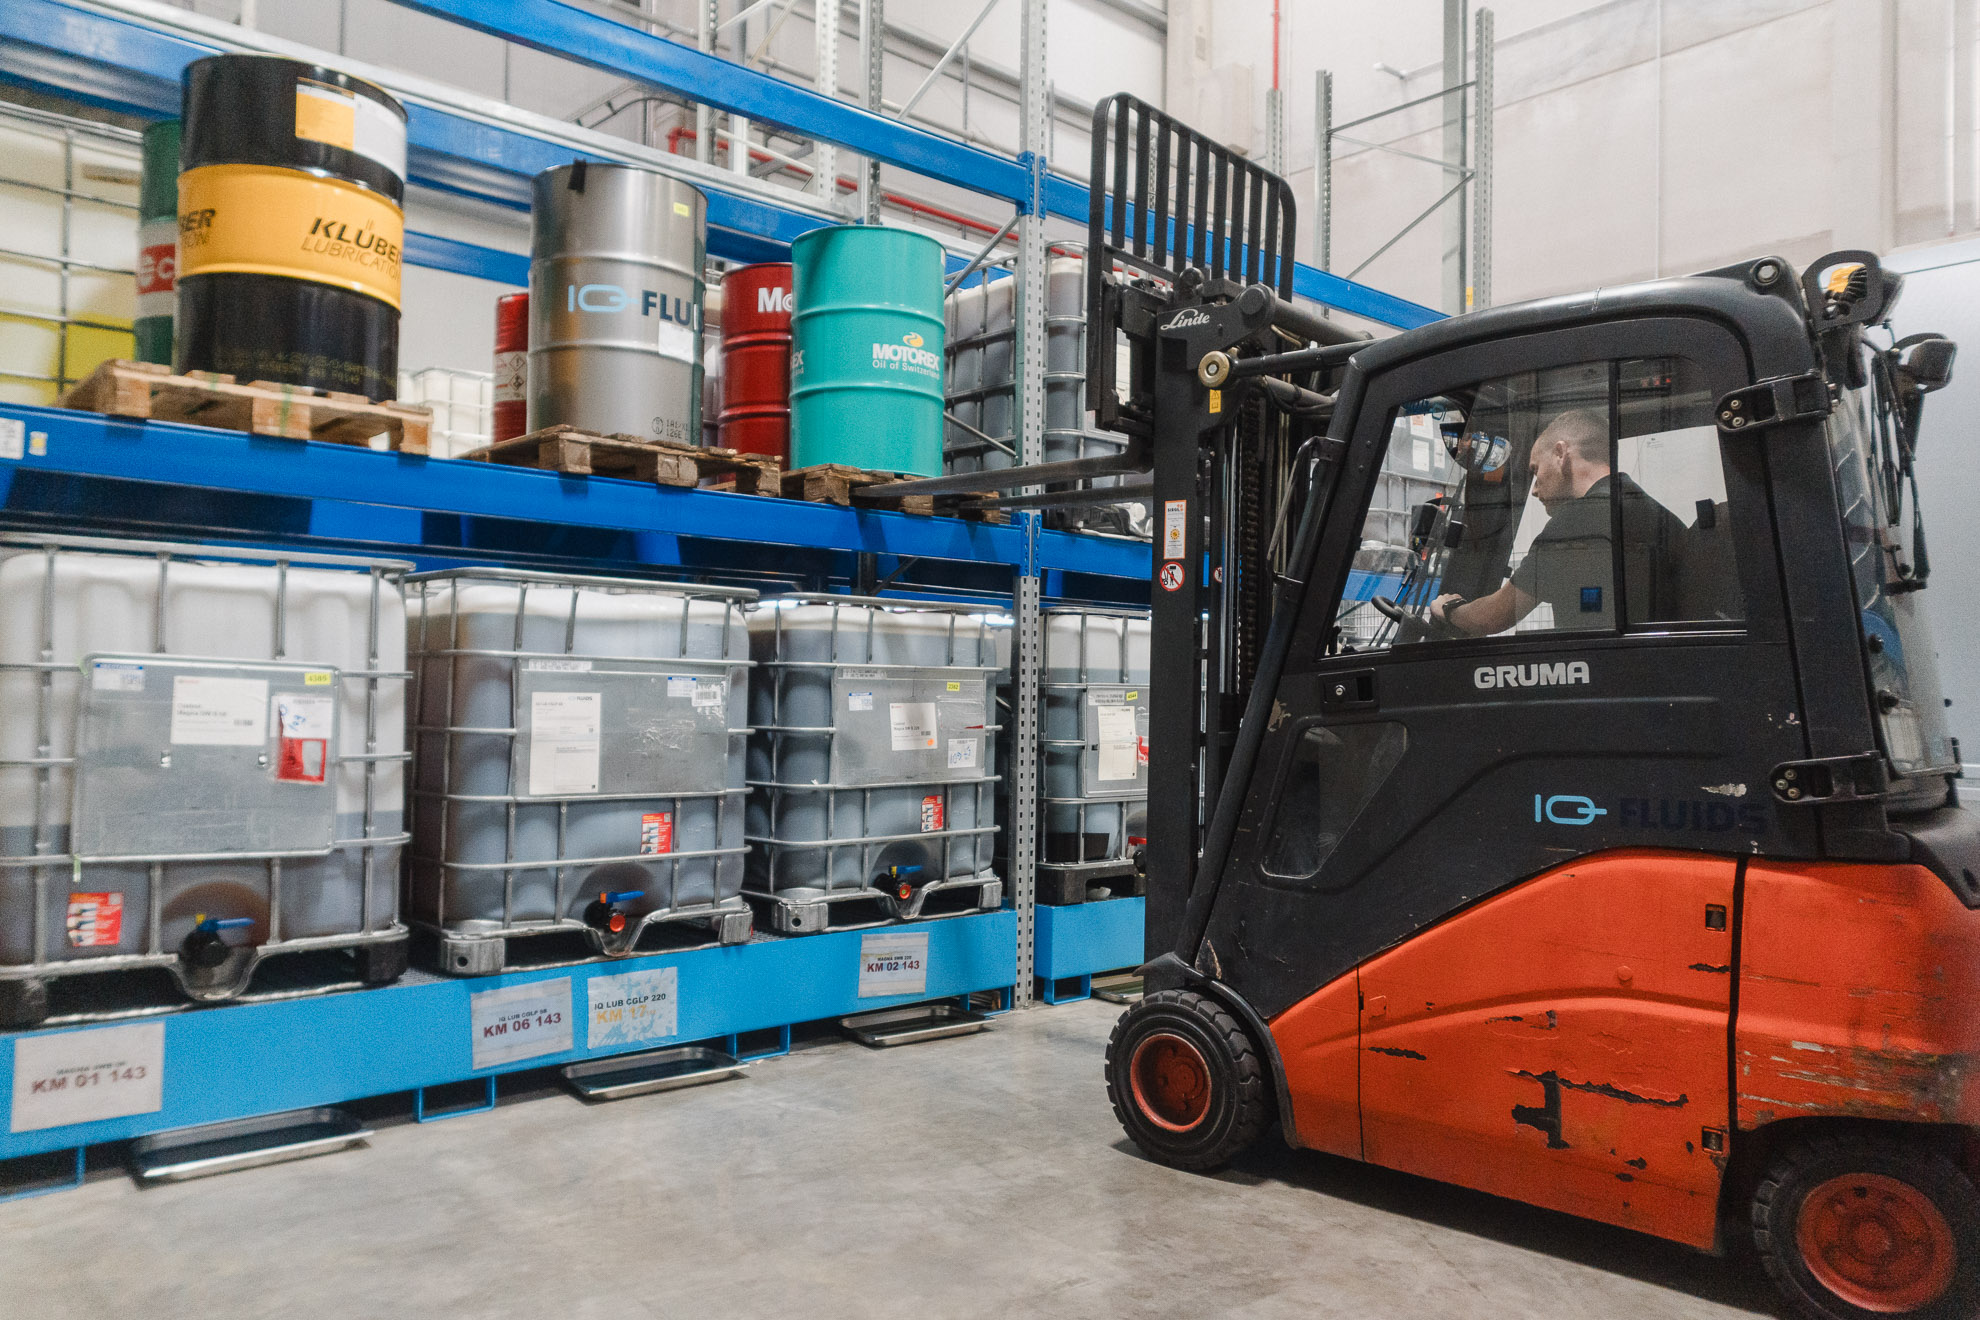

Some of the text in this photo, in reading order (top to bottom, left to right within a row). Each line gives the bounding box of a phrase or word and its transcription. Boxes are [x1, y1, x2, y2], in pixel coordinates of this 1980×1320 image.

[310, 216, 400, 265] KLÜBE
[1160, 308, 1210, 331] Linde
[872, 343, 940, 372] MOTOREX
[872, 360, 886, 369] Oil
[890, 362, 899, 370] of
[1474, 661, 1590, 689] GRUMA
[1534, 794, 1768, 834] IQ FLUIDS
[867, 960, 920, 973] KM 02 143
[594, 993, 667, 1010] IQ LUB CGLP 220
[483, 1012, 562, 1038] KM 06 143
[507, 1013, 521, 1022] LUB
[521, 1010, 539, 1019] CGLP
[596, 1009, 623, 1025] KM
[628, 1004, 647, 1020] 17
[31, 1066, 147, 1095] KM 01 143
